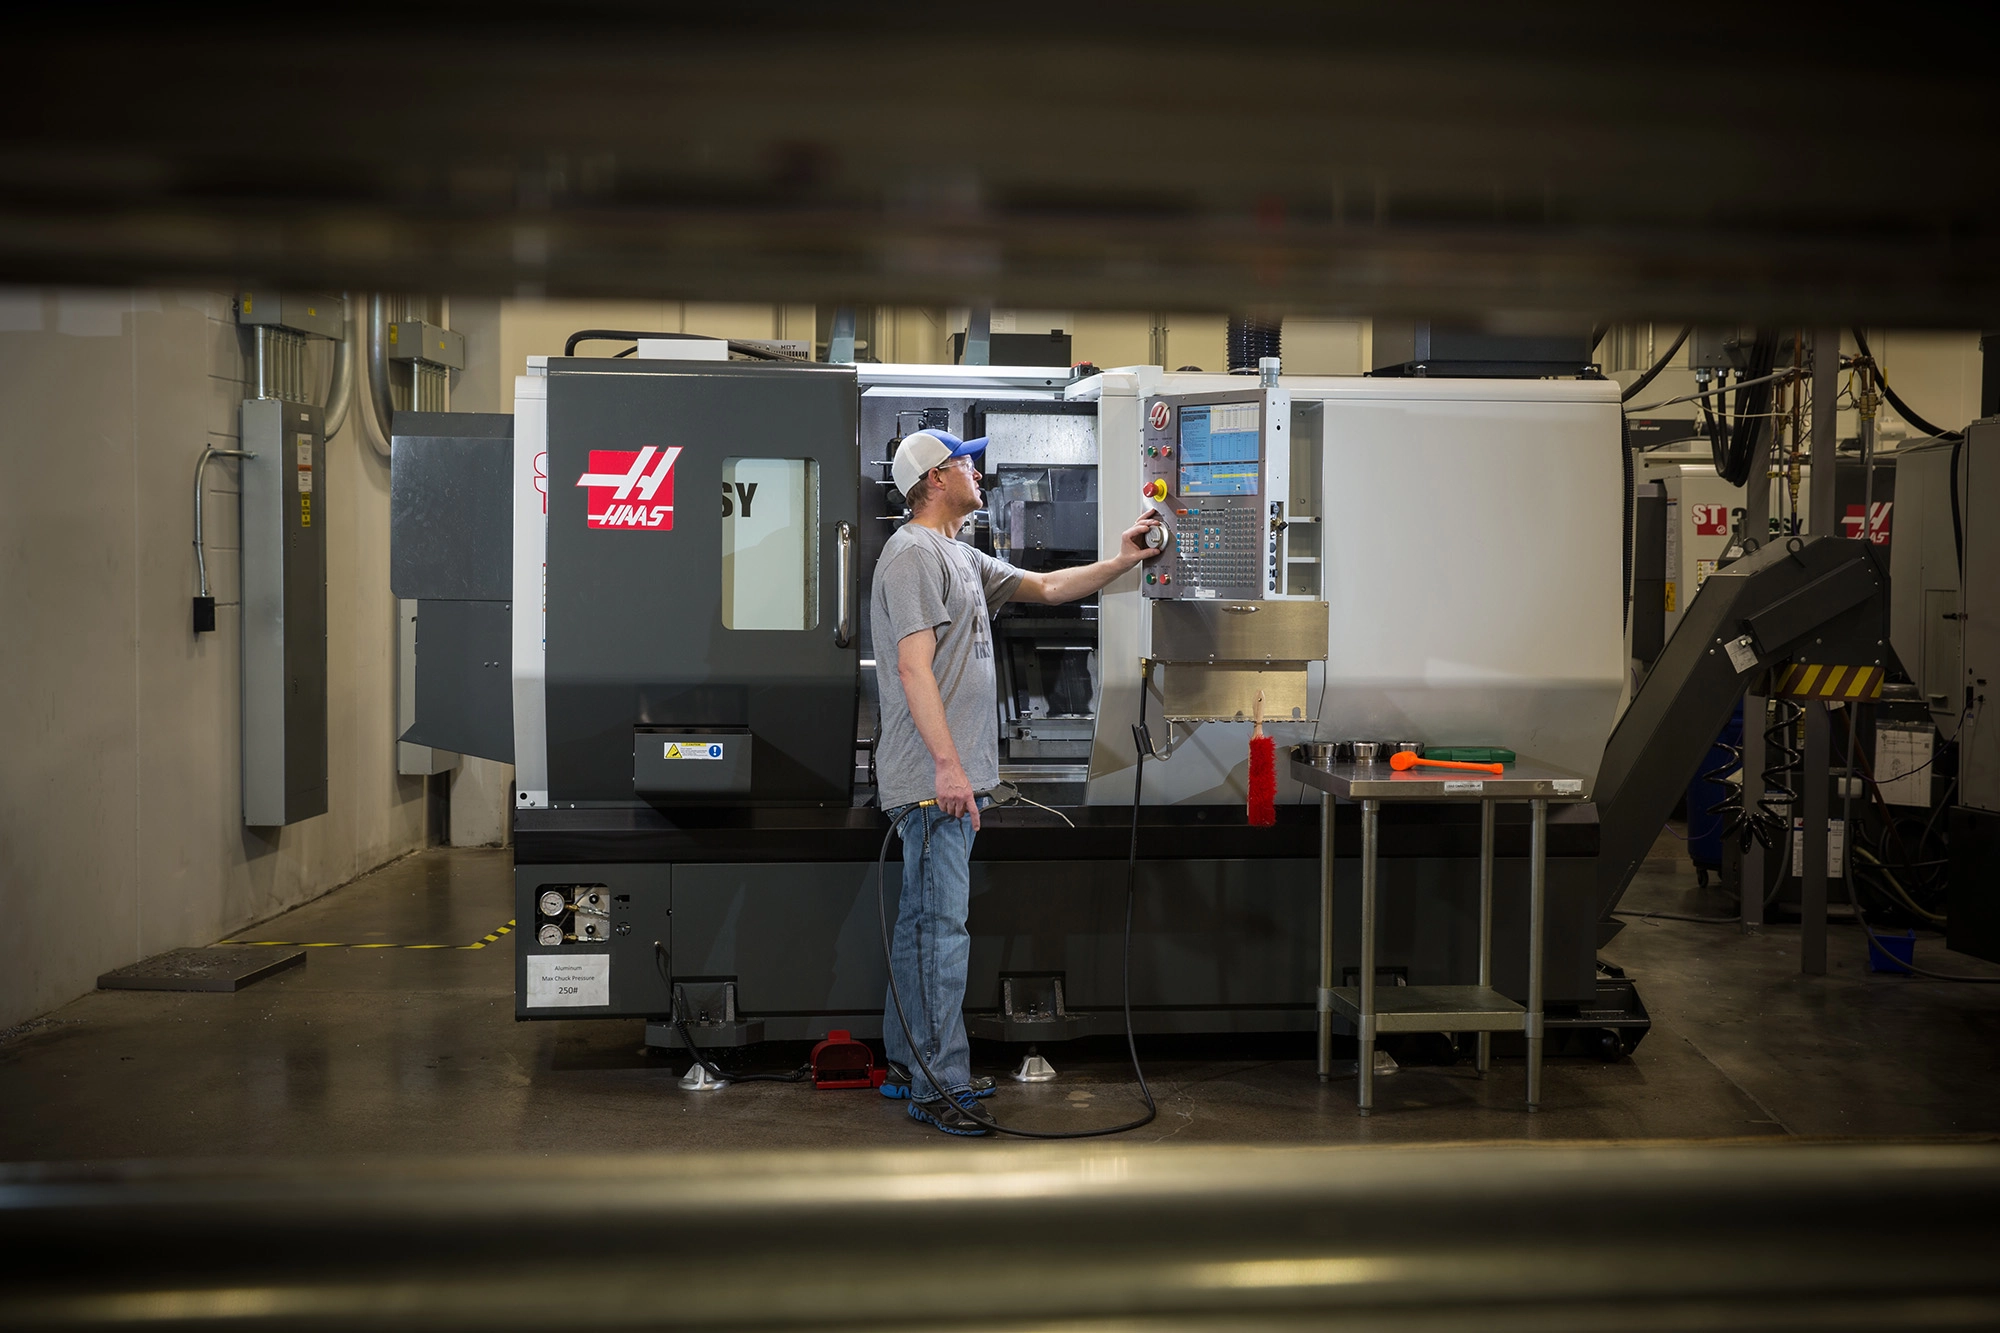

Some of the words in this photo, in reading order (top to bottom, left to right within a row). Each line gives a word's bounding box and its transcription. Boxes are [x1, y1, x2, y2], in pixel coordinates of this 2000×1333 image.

[588, 504, 673, 526] HAAS
[1692, 504, 1722, 525] ST
[558, 986, 578, 995] 250#
